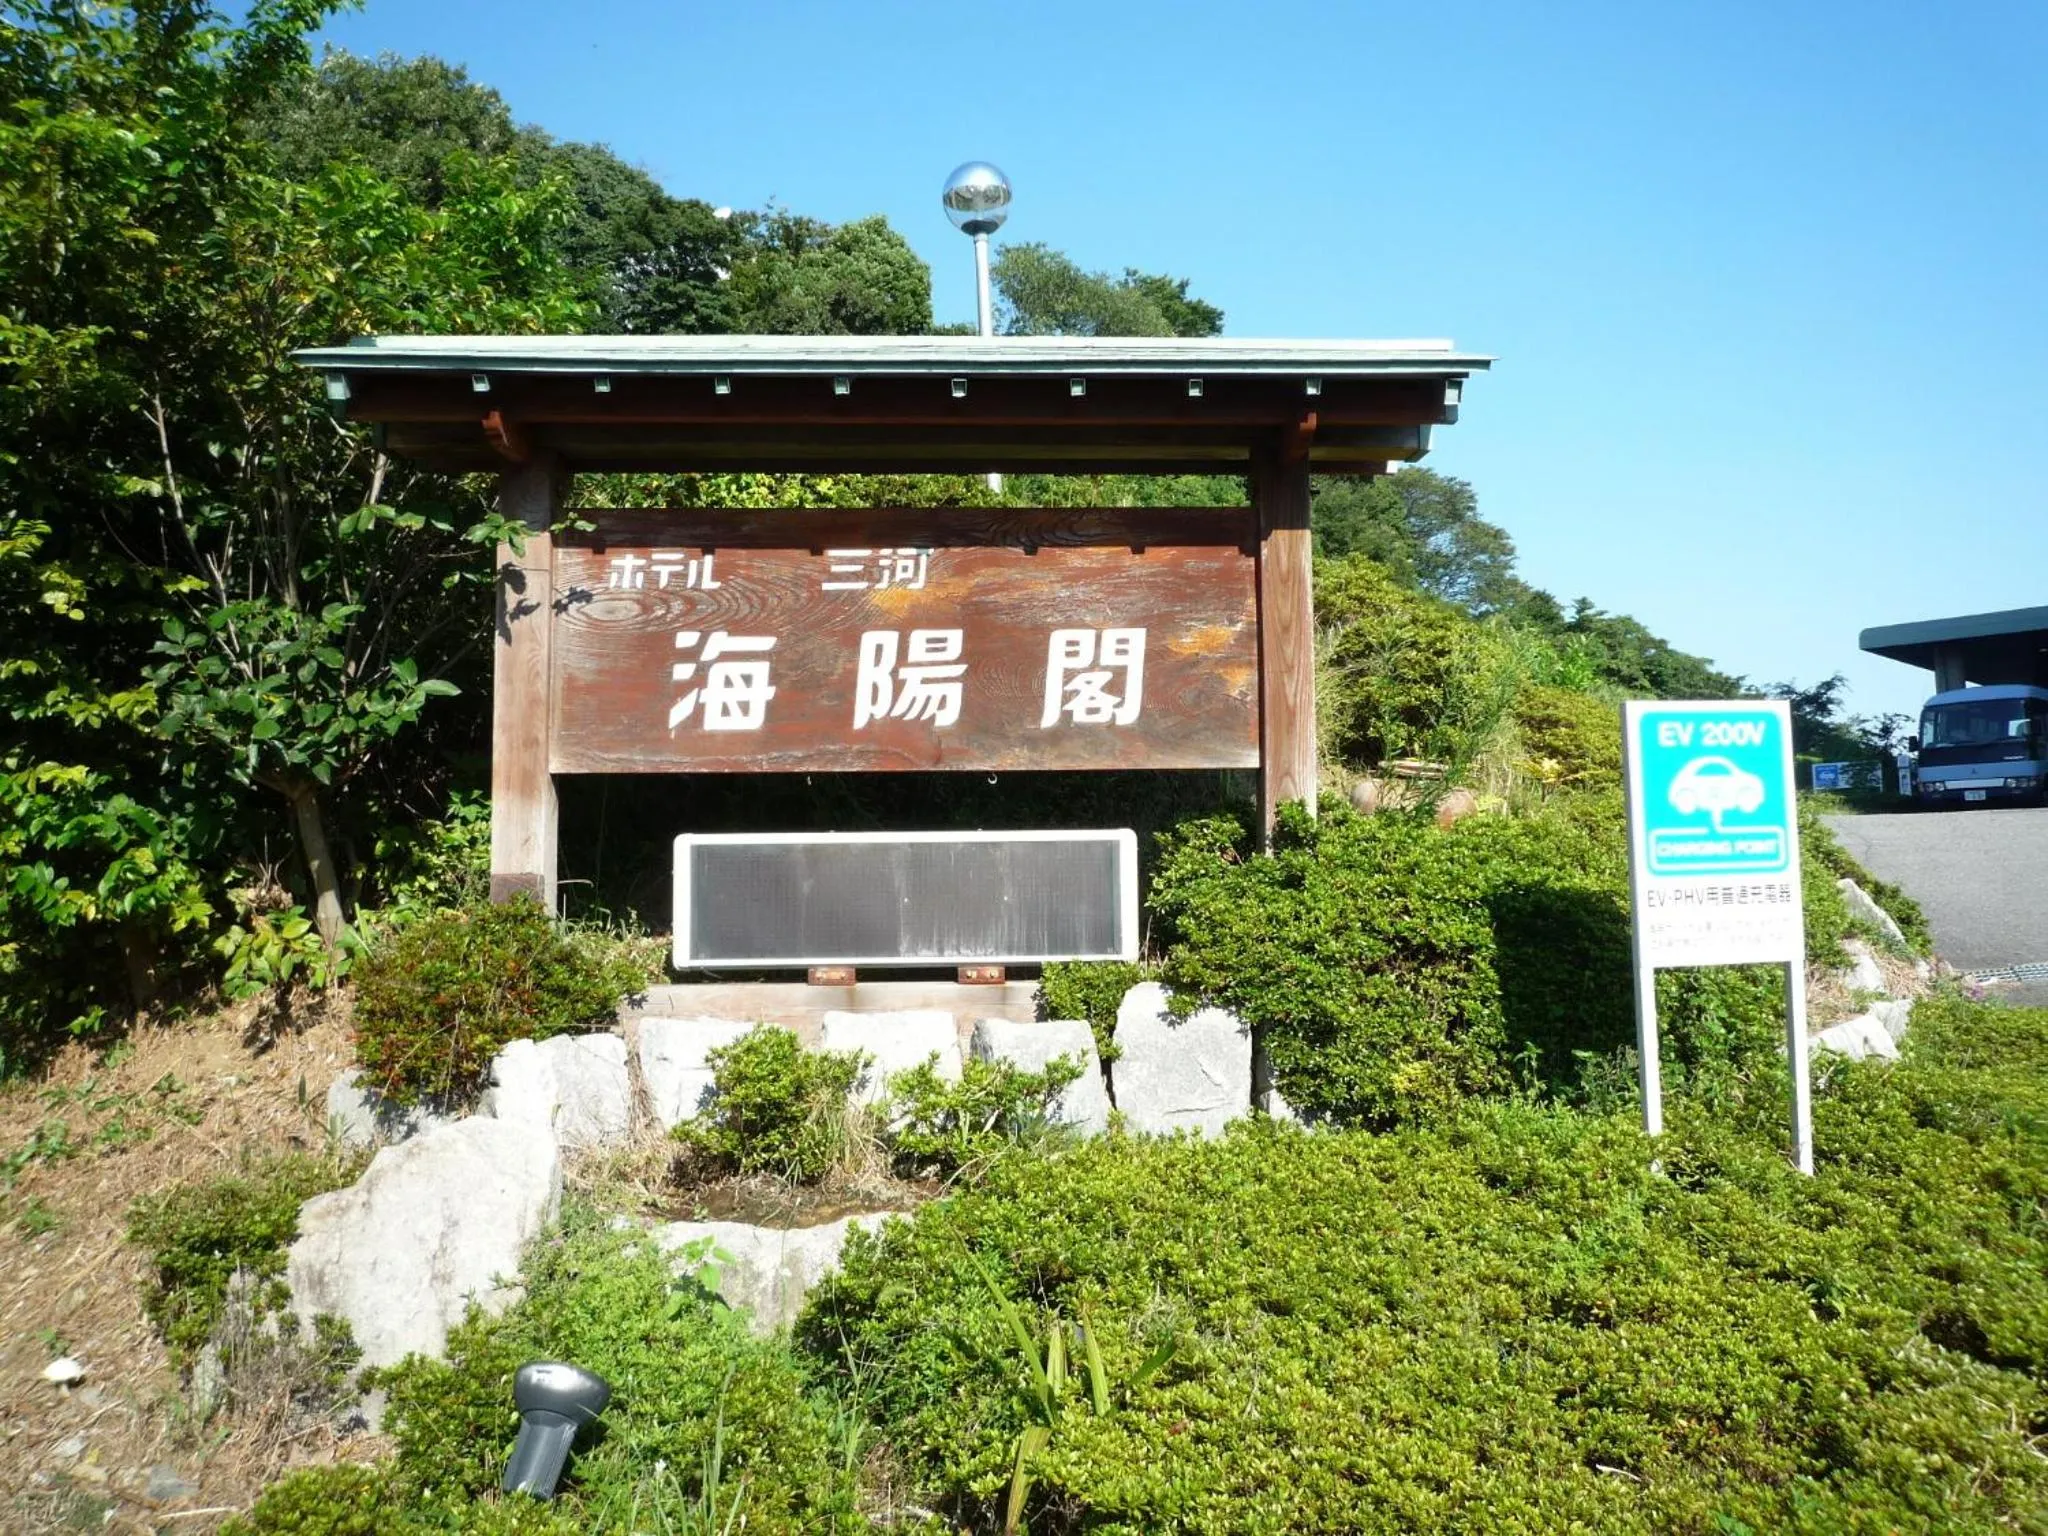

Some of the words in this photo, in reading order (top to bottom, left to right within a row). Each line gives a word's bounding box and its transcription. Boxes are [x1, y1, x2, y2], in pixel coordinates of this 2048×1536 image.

[608, 551, 721, 591] ホテル
[820, 548, 929, 591] 三河
[669, 628, 1148, 732] 海陽閣
[1657, 722, 1695, 747] EV
[1701, 721, 1766, 746] 200V
